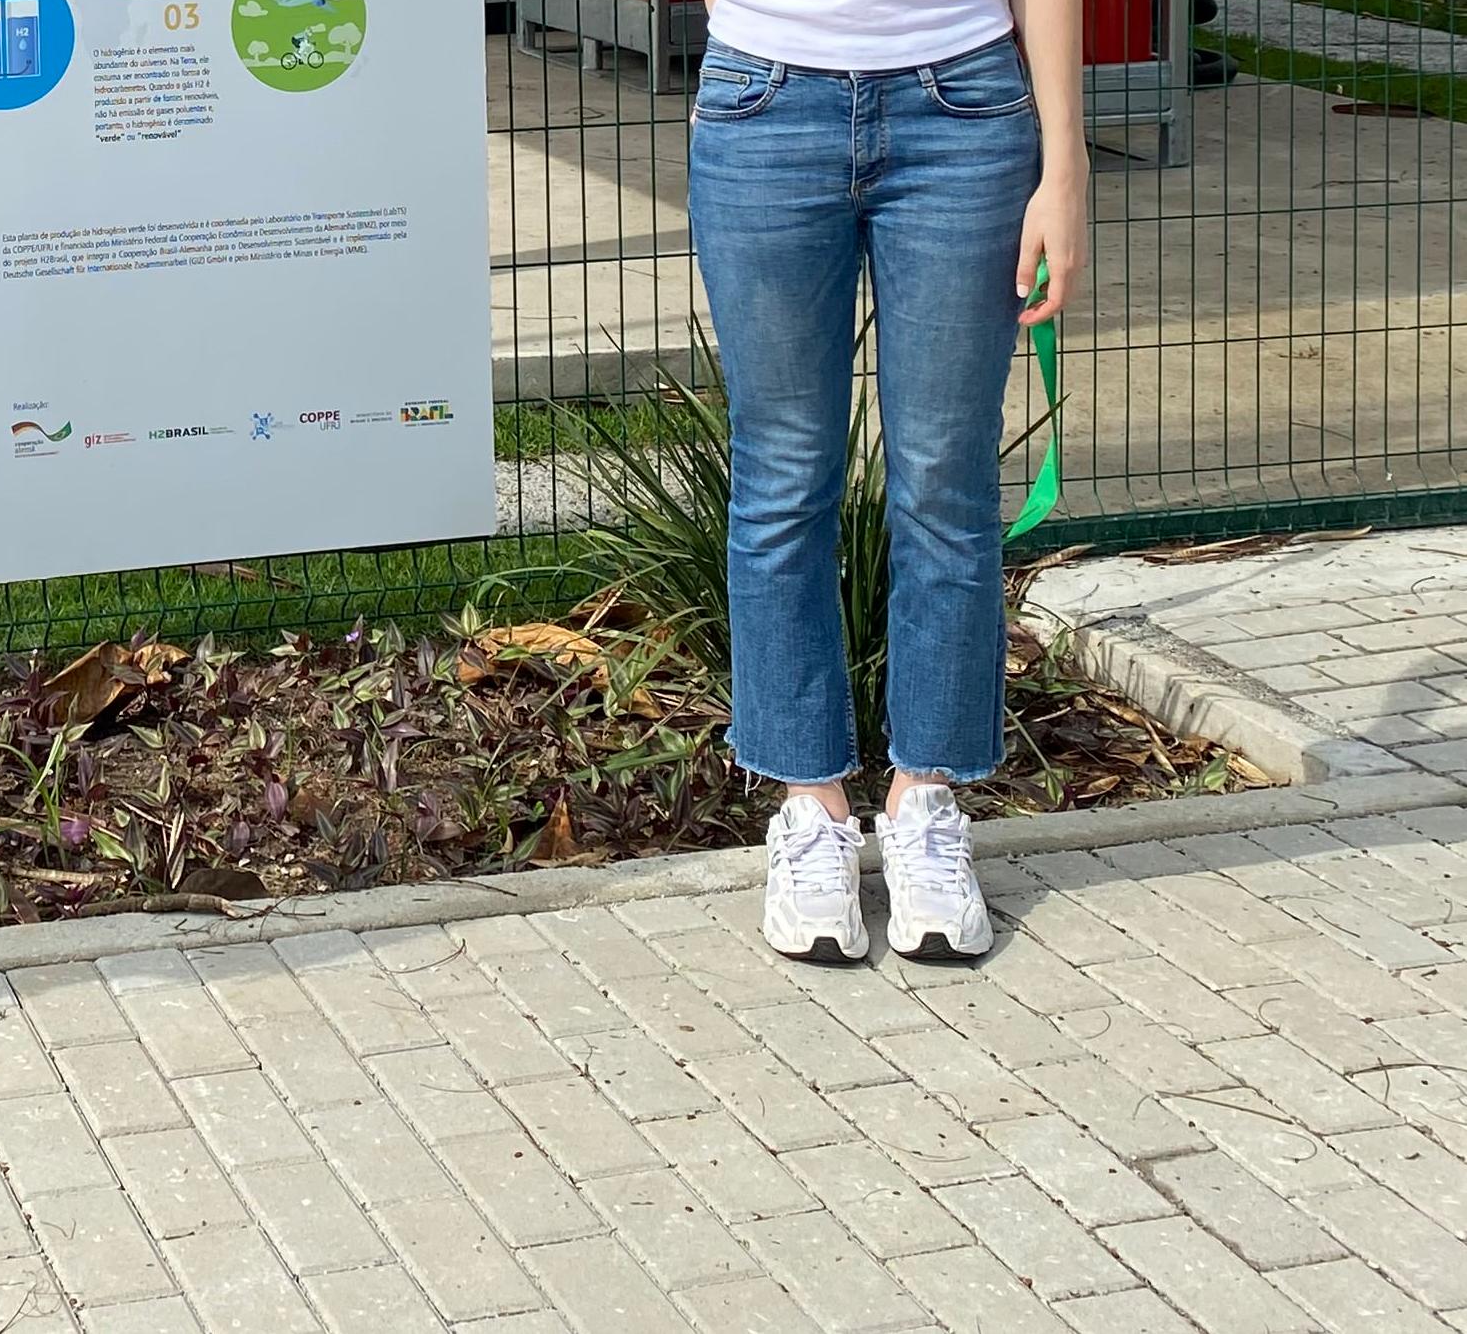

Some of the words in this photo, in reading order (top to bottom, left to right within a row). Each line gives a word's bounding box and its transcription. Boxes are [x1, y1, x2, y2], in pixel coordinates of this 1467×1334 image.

[163, 3, 200, 31] 03
[16, 28, 29, 36] H2
[299, 410, 341, 424] COPPE
[149, 426, 209, 440] H2BRASIL
[84, 433, 102, 449] giz
